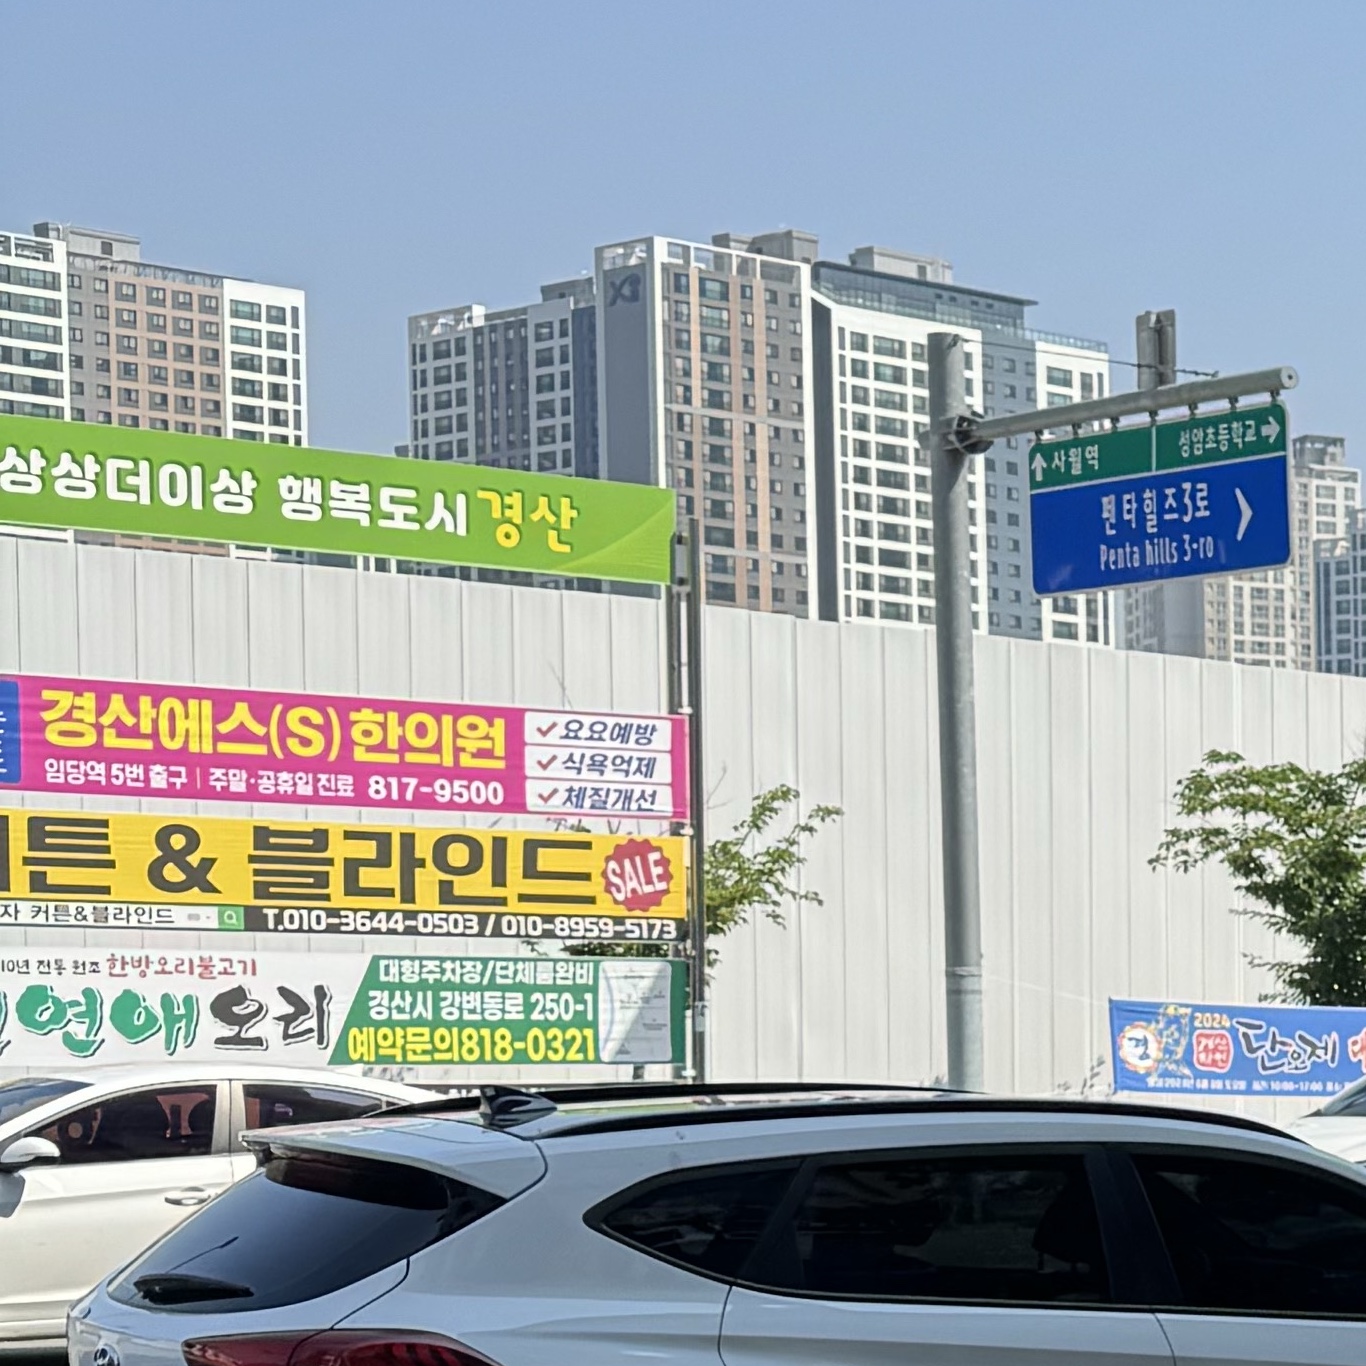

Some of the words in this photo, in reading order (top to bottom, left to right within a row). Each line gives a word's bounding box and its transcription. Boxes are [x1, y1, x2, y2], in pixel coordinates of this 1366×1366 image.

[1178, 420, 1257, 458] 성암초등학교
[1051, 444, 1099, 475] 사월역
[0, 446, 258, 515] 상상더이상
[277, 475, 468, 537] 행복도시
[476, 488, 578, 553] 경산
[1101, 482, 1211, 536] 펜타힐즈3로
[1100, 541, 1140, 572] Penta
[1145, 537, 1178, 566] hills
[1183, 534, 1215, 562] 3-ro
[40, 689, 342, 762] 경산에스(S)
[349, 708, 506, 769] 한의원
[559, 719, 657, 746] 요요예방
[44, 758, 106, 786] 임당역
[110, 763, 146, 788] 5번
[149, 763, 188, 790] 출구
[317, 773, 355, 797] 진료
[368, 775, 504, 805] 817-9500
[562, 752, 657, 779] 식욕억제
[562, 786, 657, 812] 체질개선
[147, 824, 223, 895] &
[248, 825, 597, 907] 블라인드
[606, 851, 669, 902] SALE
[501, 914, 678, 939] 010-8959-5173
[37, 959, 66, 976] 전통
[72, 960, 102, 975] 원조
[106, 953, 257, 979] 한방오리불고기
[368, 990, 433, 1021] 경산시
[440, 991, 525, 1021] 강변동로
[530, 992, 594, 1021] 250-1
[1194, 1013, 1231, 1028] 2024
[1234, 1019, 1338, 1073] 단오제
